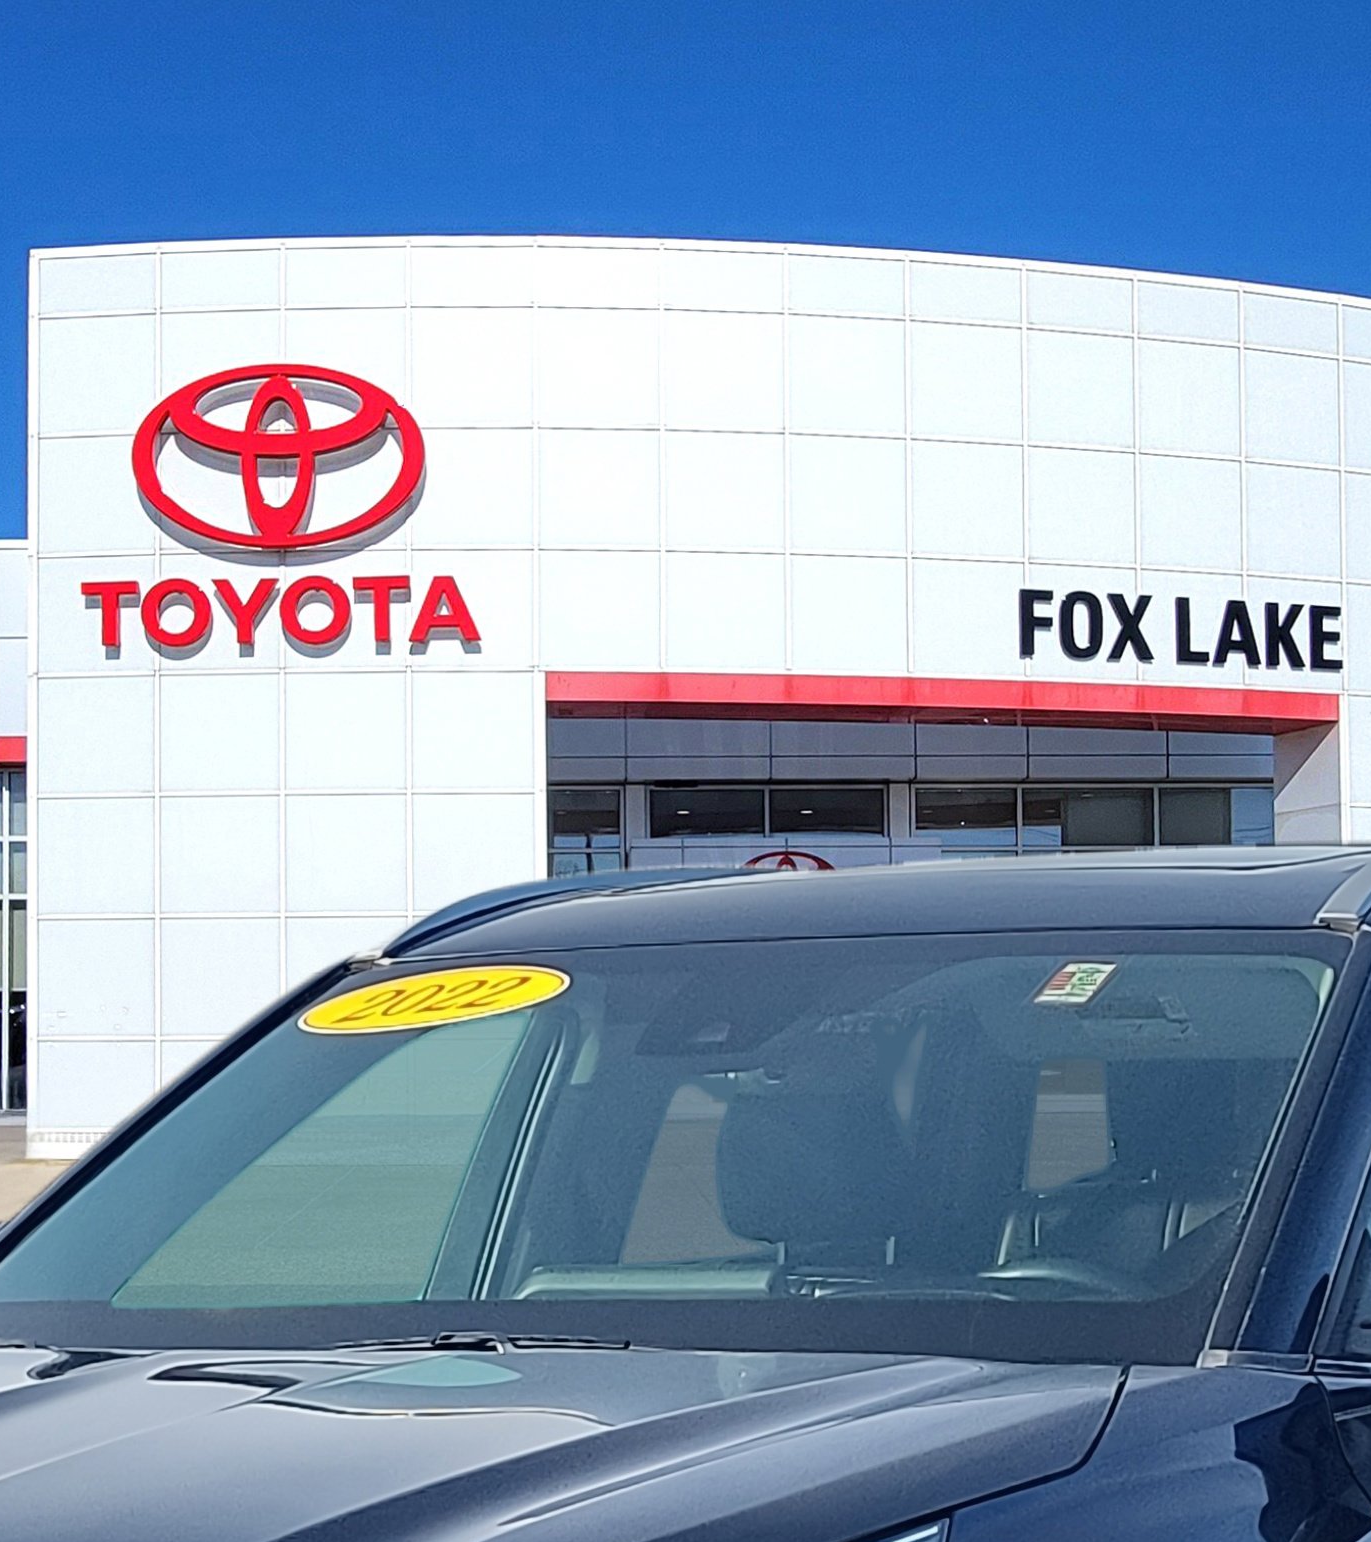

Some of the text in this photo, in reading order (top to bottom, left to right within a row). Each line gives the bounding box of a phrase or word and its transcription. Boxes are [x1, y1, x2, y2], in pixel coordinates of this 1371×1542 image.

[81, 574, 483, 654] TOYOTA
[1019, 588, 1344, 672] FOX LAKE
[331, 976, 532, 1023] 2022
